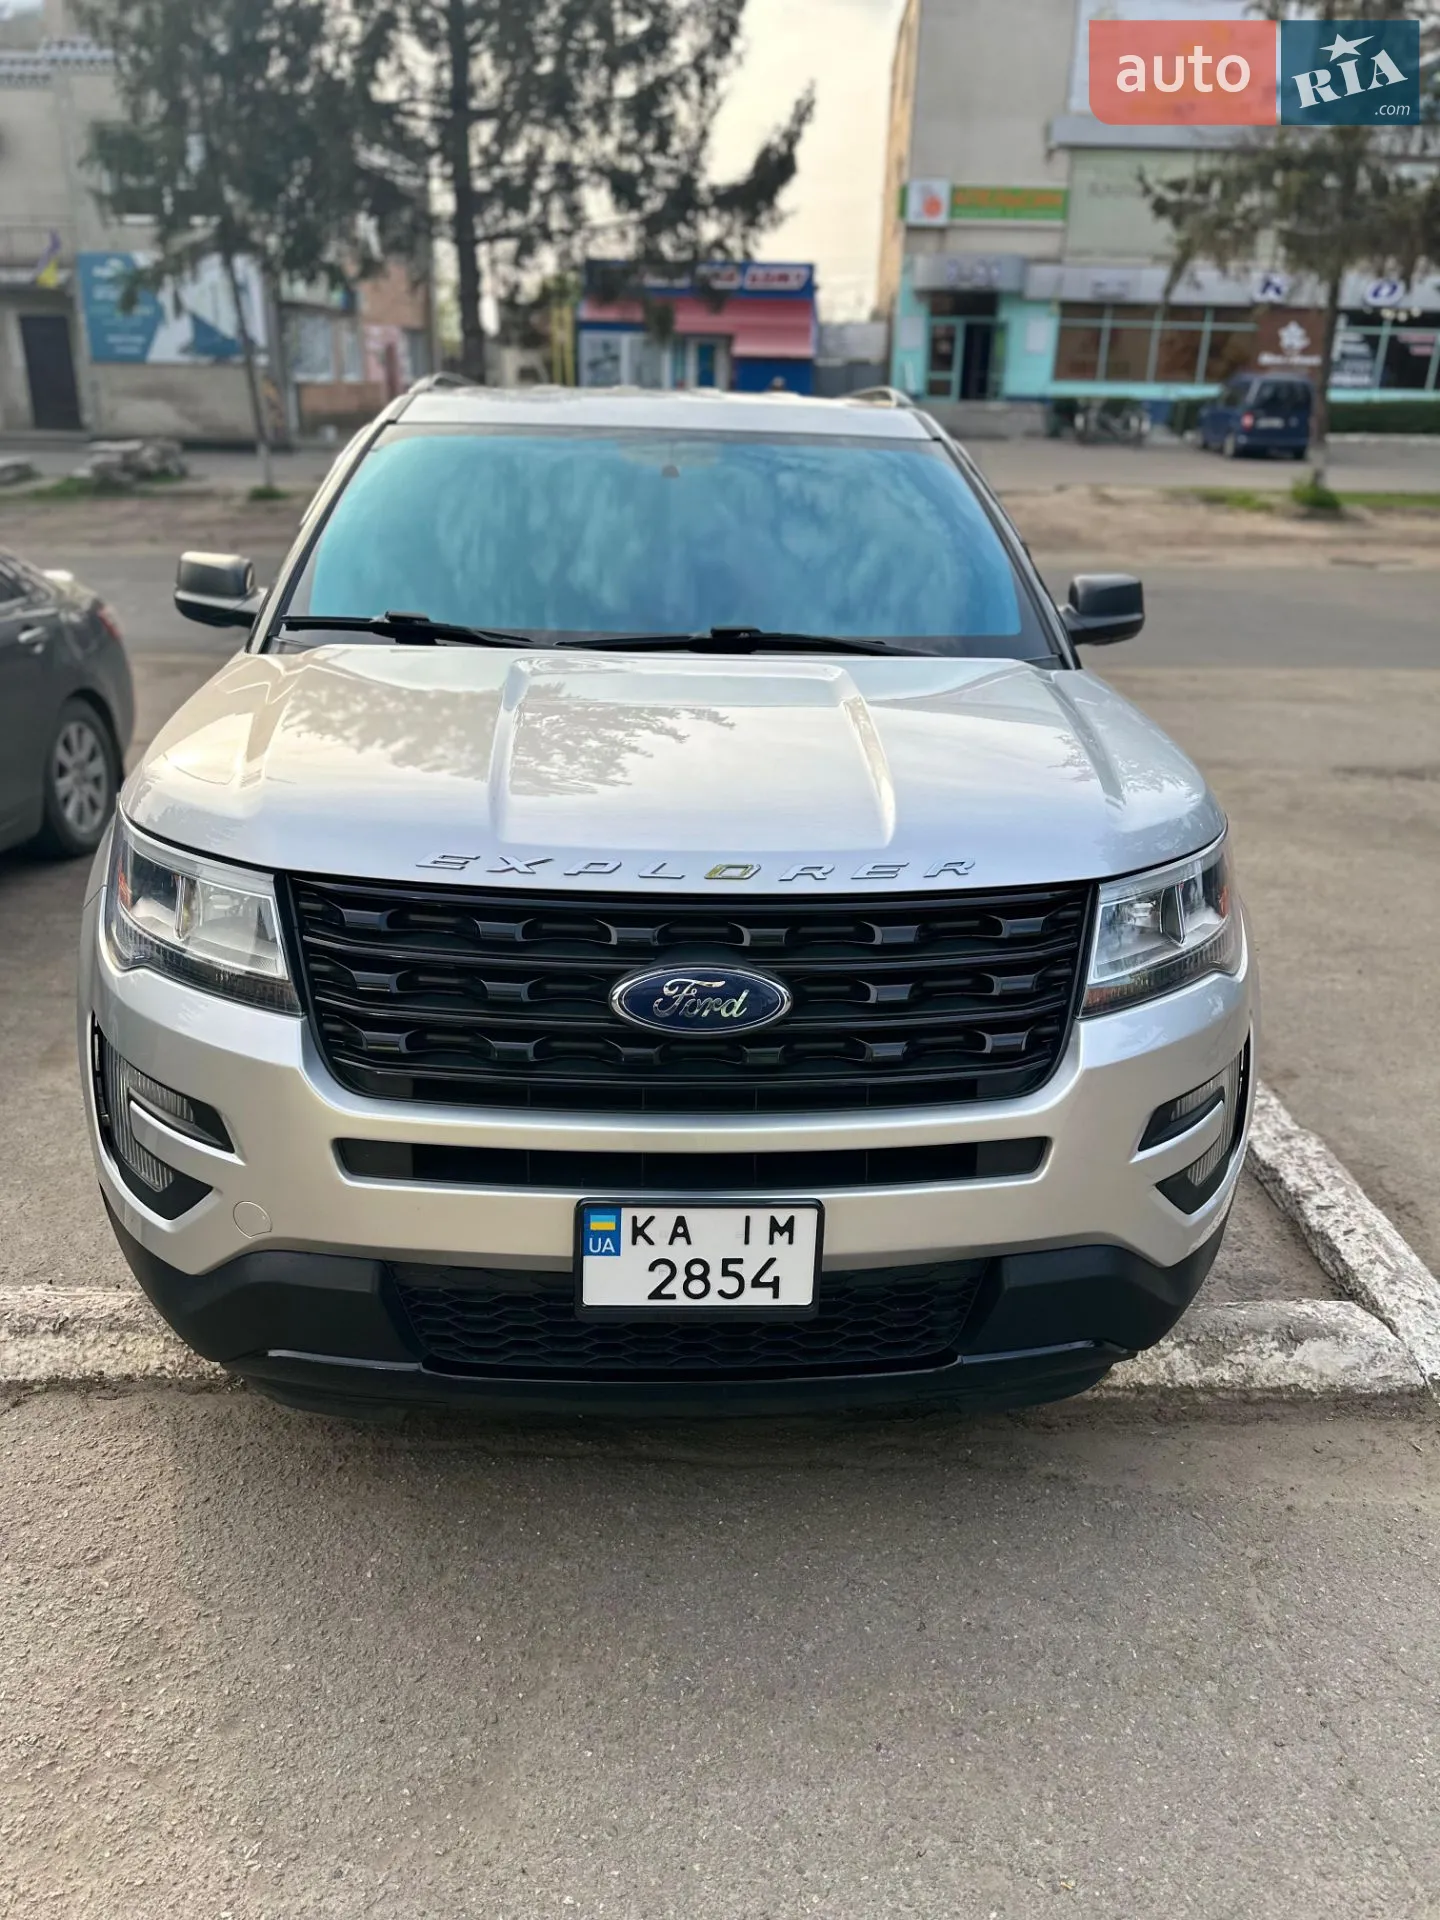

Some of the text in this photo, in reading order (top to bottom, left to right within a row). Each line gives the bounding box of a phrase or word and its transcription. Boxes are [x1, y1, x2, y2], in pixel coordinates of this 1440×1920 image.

[415, 854, 976, 882] EXPLORER
[652, 978, 750, 1018] Ford
[588, 1237, 616, 1253] UA
[631, 1214, 795, 1246] KA IM
[647, 1257, 780, 1300] 2854
